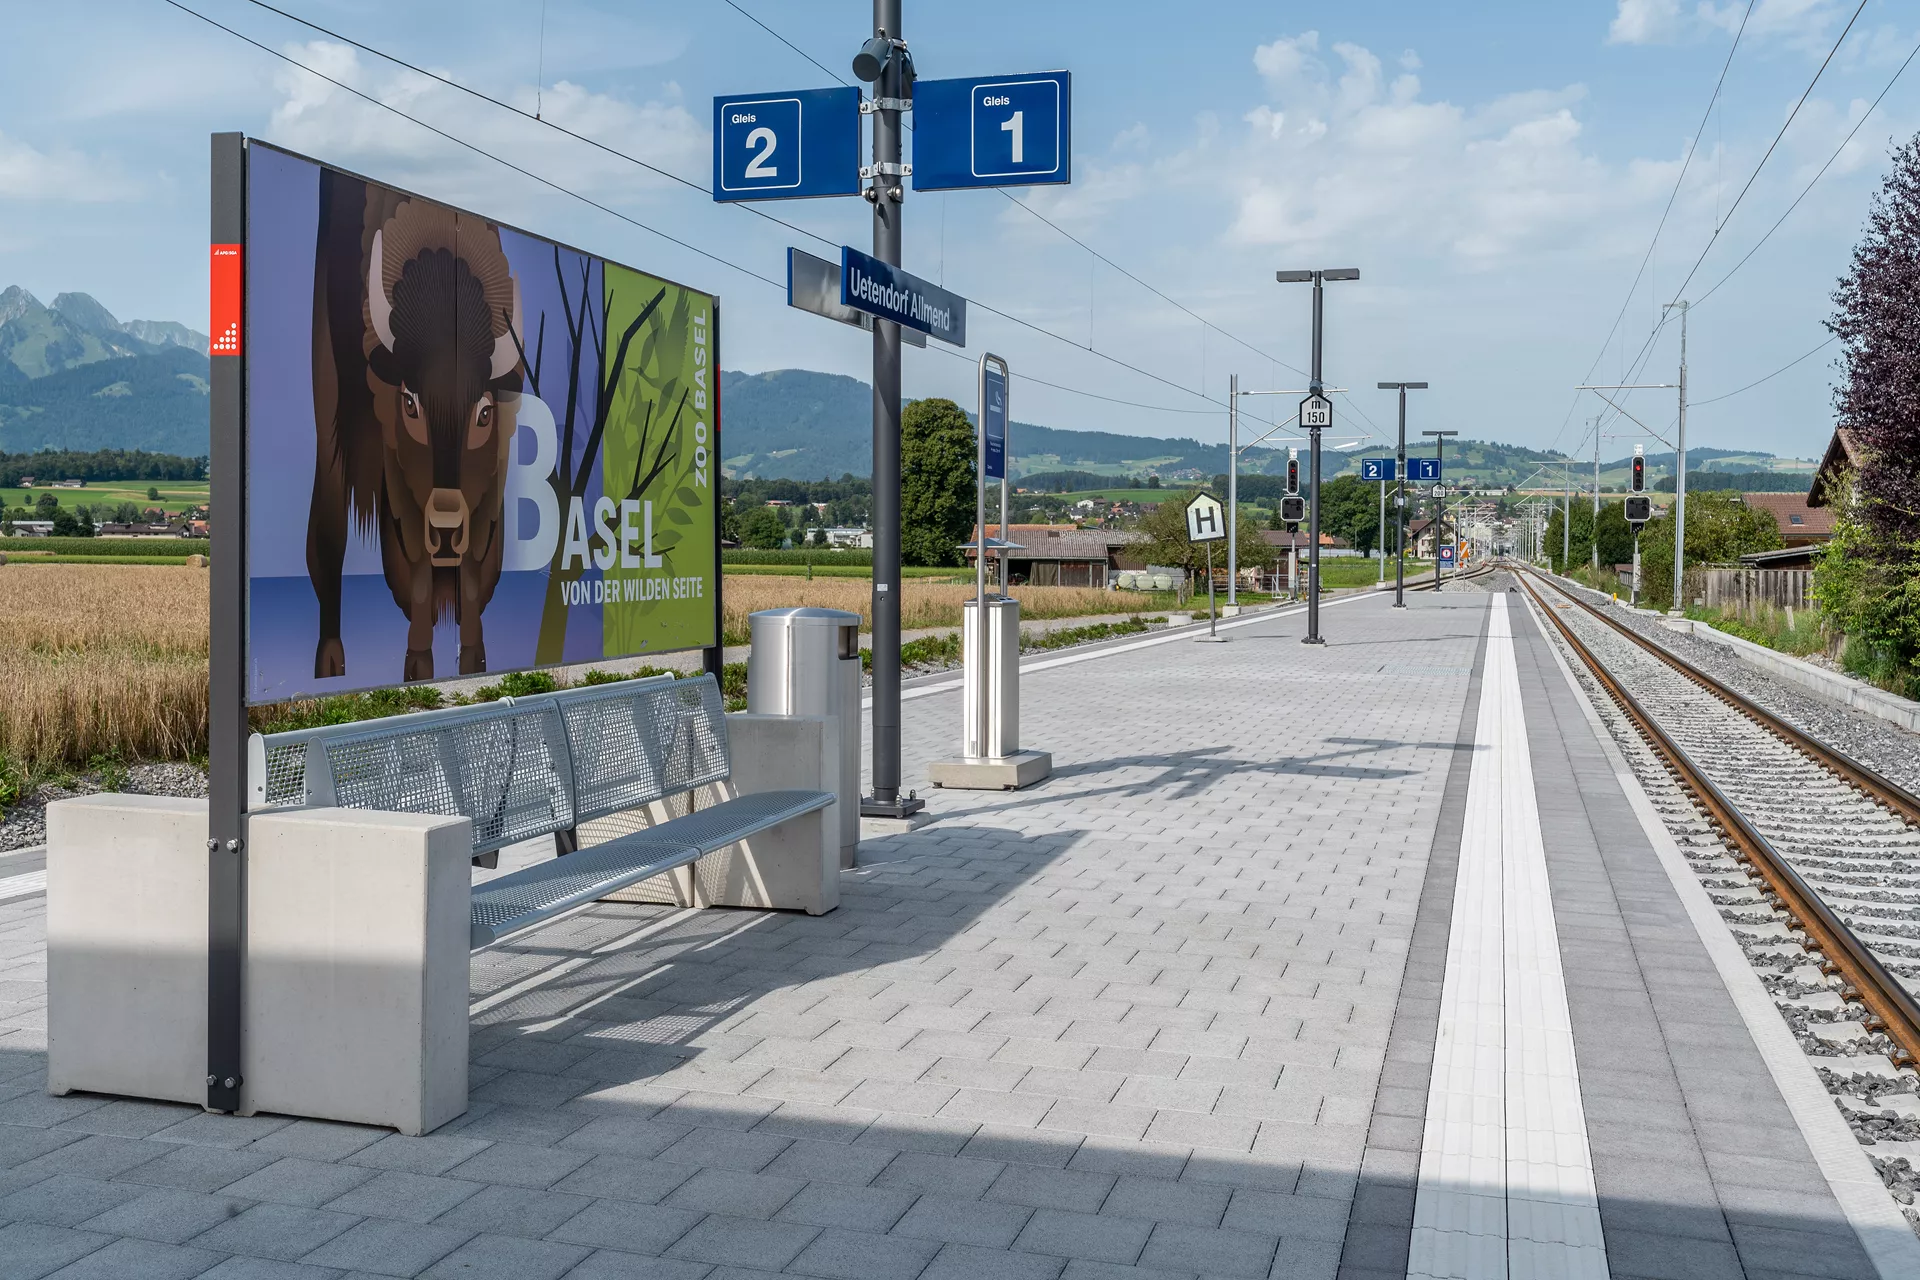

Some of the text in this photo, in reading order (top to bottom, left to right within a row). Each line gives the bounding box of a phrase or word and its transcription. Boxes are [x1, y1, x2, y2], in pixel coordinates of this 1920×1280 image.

[983, 96, 1010, 107] Gleis
[732, 113, 757, 125] Gleis
[1000, 111, 1024, 163] 1
[744, 127, 777, 179] 2
[850, 267, 950, 332] Uetendorf Allmend
[694, 309, 707, 488] ZOO BASEL
[1311, 401, 1321, 410] m
[1307, 411, 1325, 424] 150
[1368, 465, 1378, 477] 2
[1426, 465, 1433, 477] 1
[1195, 506, 1217, 534] H
[561, 576, 703, 606] VON DER WILDEN SEITE
